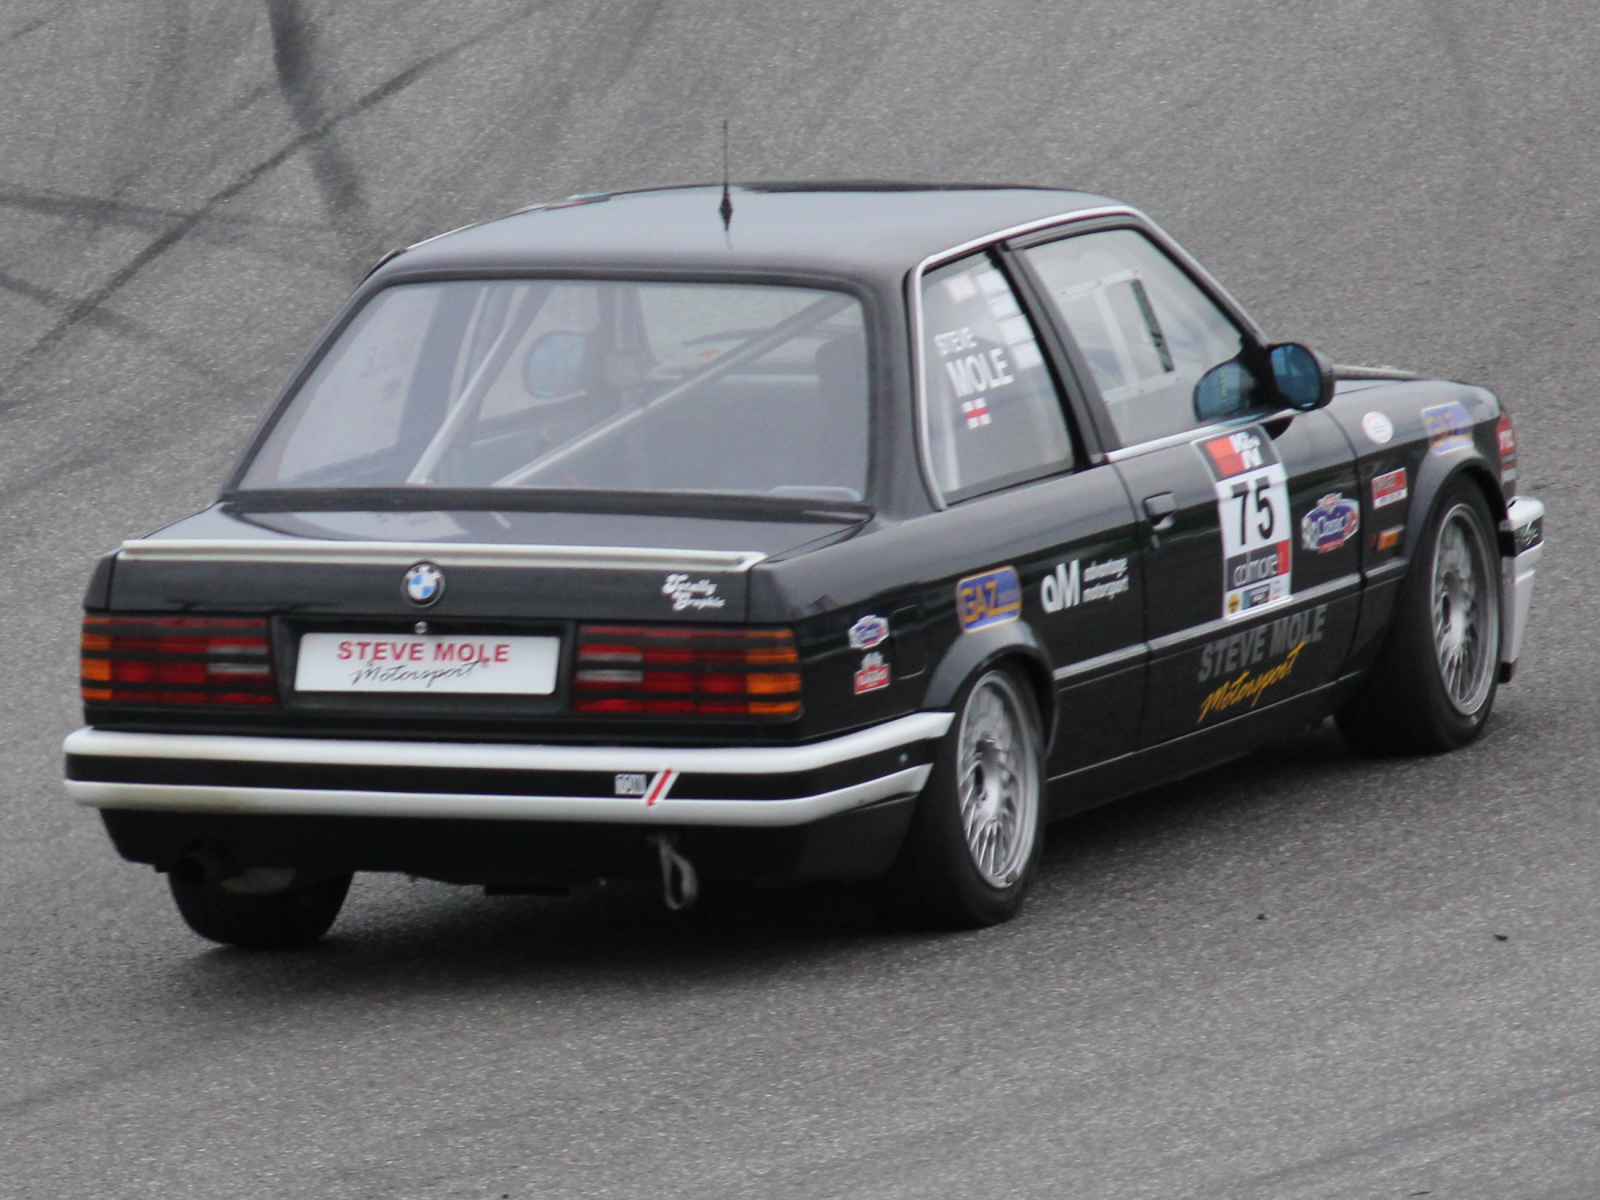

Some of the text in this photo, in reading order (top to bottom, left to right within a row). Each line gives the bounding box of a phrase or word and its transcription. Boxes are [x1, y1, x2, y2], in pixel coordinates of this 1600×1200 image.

[934, 326, 978, 355] STEVE
[945, 347, 1015, 398] MOLE
[1230, 474, 1275, 546] 75
[338, 640, 511, 663] STEVE MOLE
[1198, 603, 1328, 683] STEVE MOLE
[350, 660, 487, 688] Motorsport
[1197, 641, 1306, 724] Motorsport
